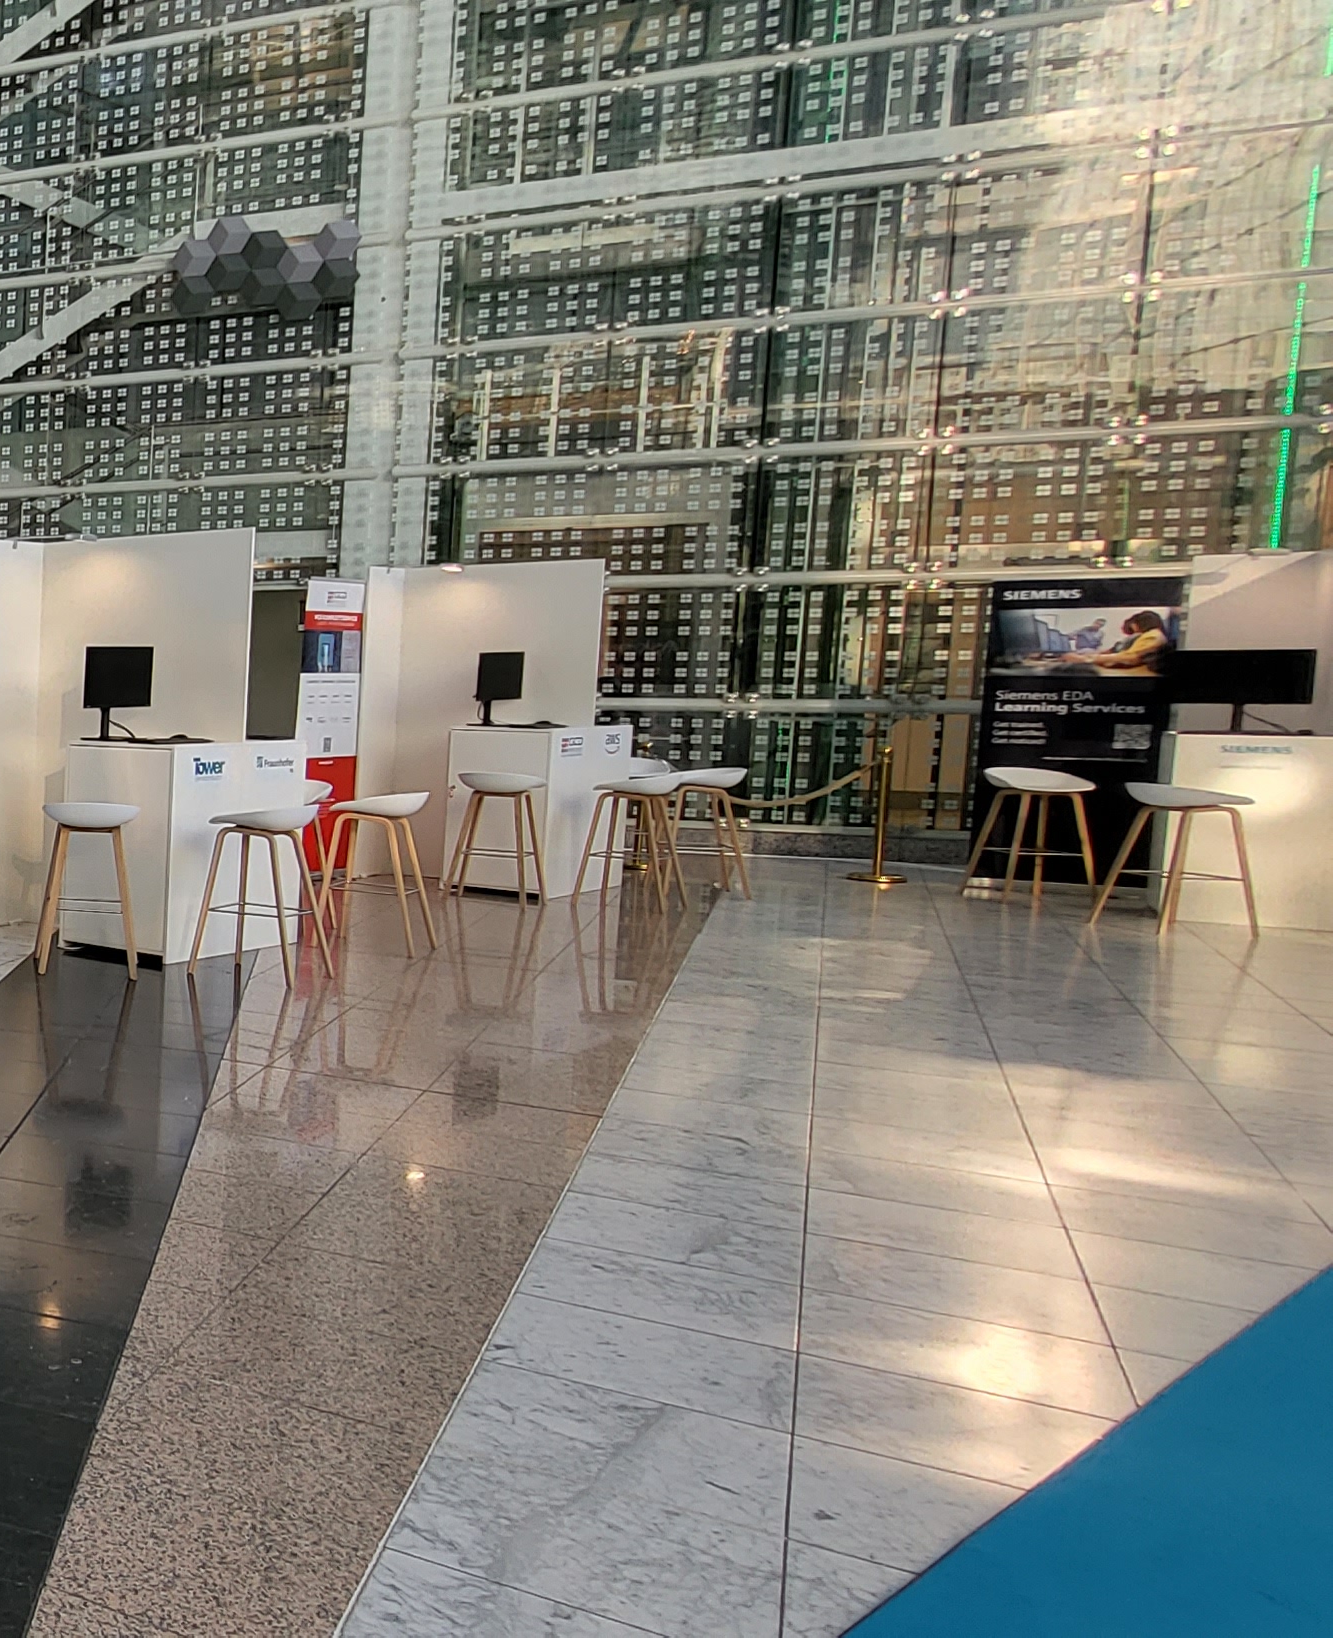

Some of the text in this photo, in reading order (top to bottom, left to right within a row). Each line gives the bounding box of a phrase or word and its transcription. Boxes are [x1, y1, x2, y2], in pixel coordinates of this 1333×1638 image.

[1002, 588, 1082, 601] SIEMENS
[995, 689, 1095, 701] Siemens EDA
[994, 702, 1146, 715] Learning Services
[1220, 745, 1293, 754] SIEMENS
[193, 757, 225, 775] Tower
